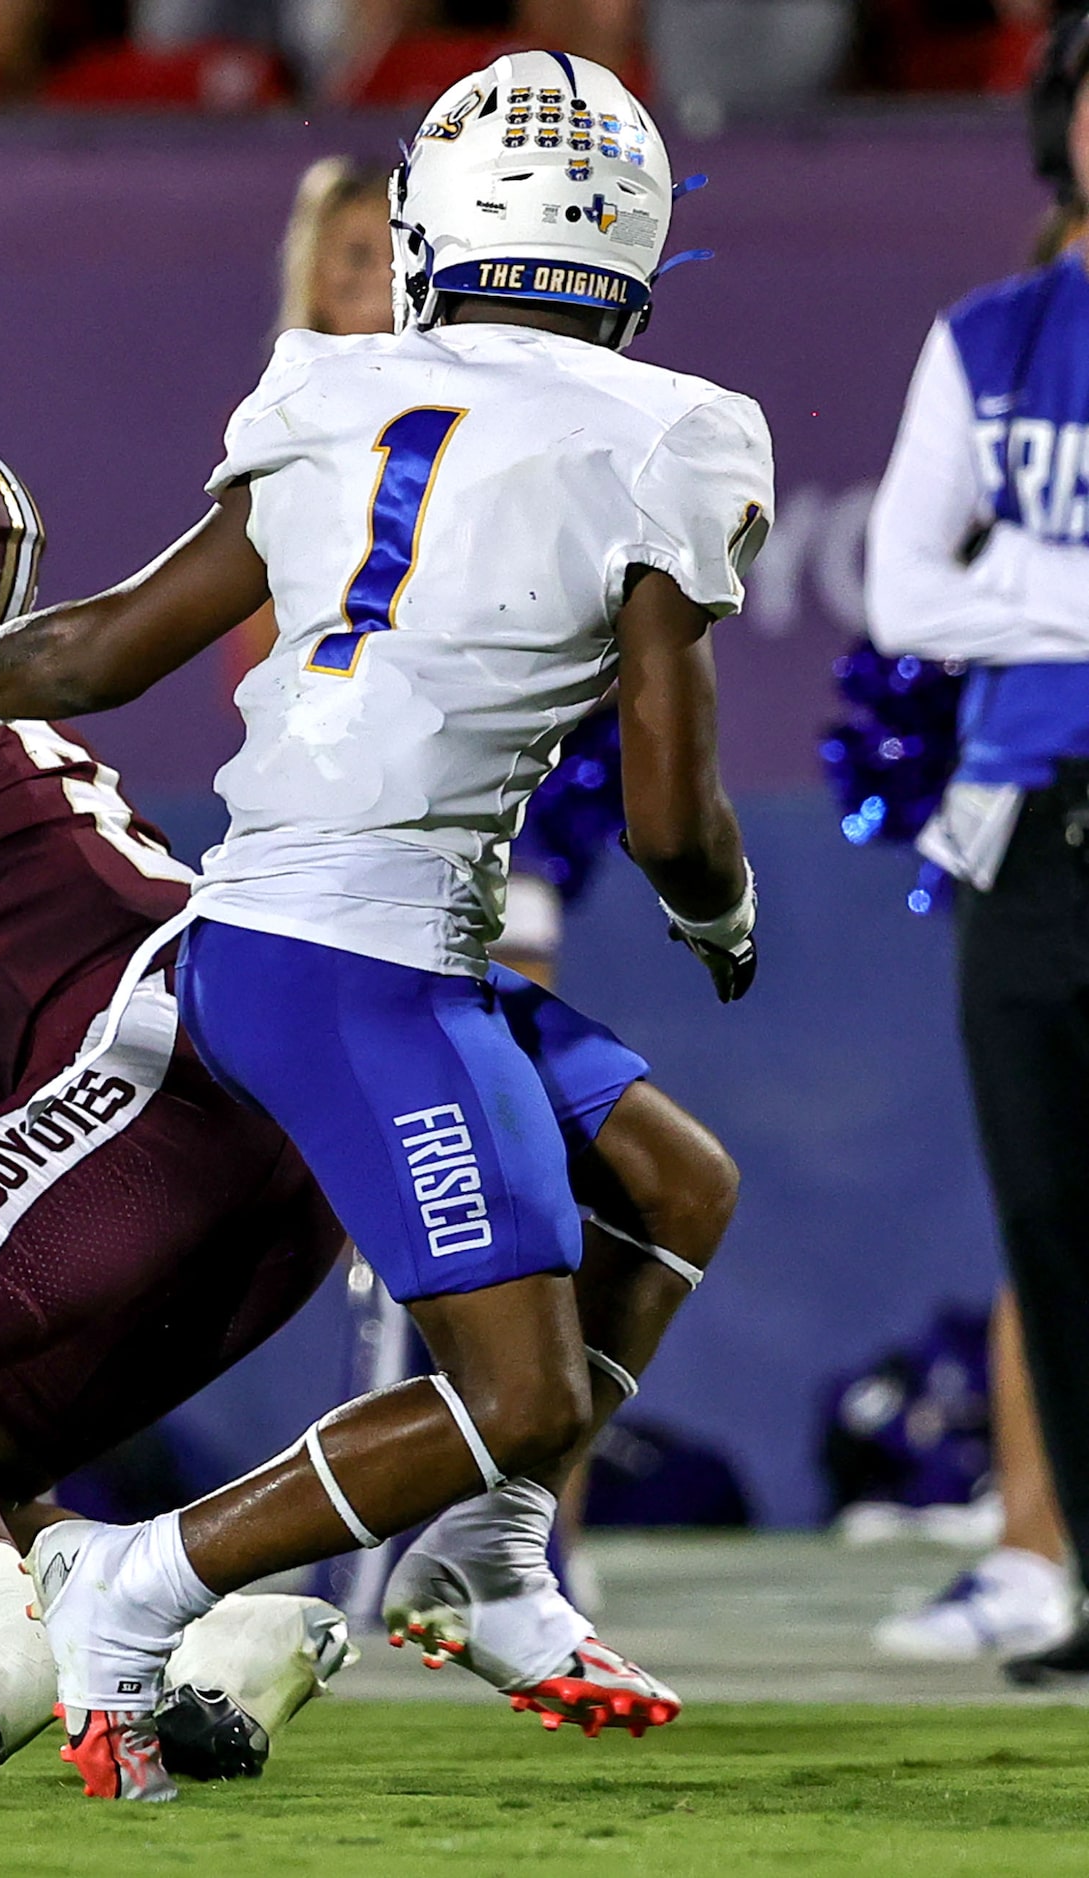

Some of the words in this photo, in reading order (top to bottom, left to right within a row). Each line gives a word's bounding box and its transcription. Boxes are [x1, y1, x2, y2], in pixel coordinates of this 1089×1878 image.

[479, 263, 525, 288] THE
[533, 266, 627, 303] ORIGINAL
[305, 404, 470, 678] 1
[393, 1103, 492, 1258] FRISCO
